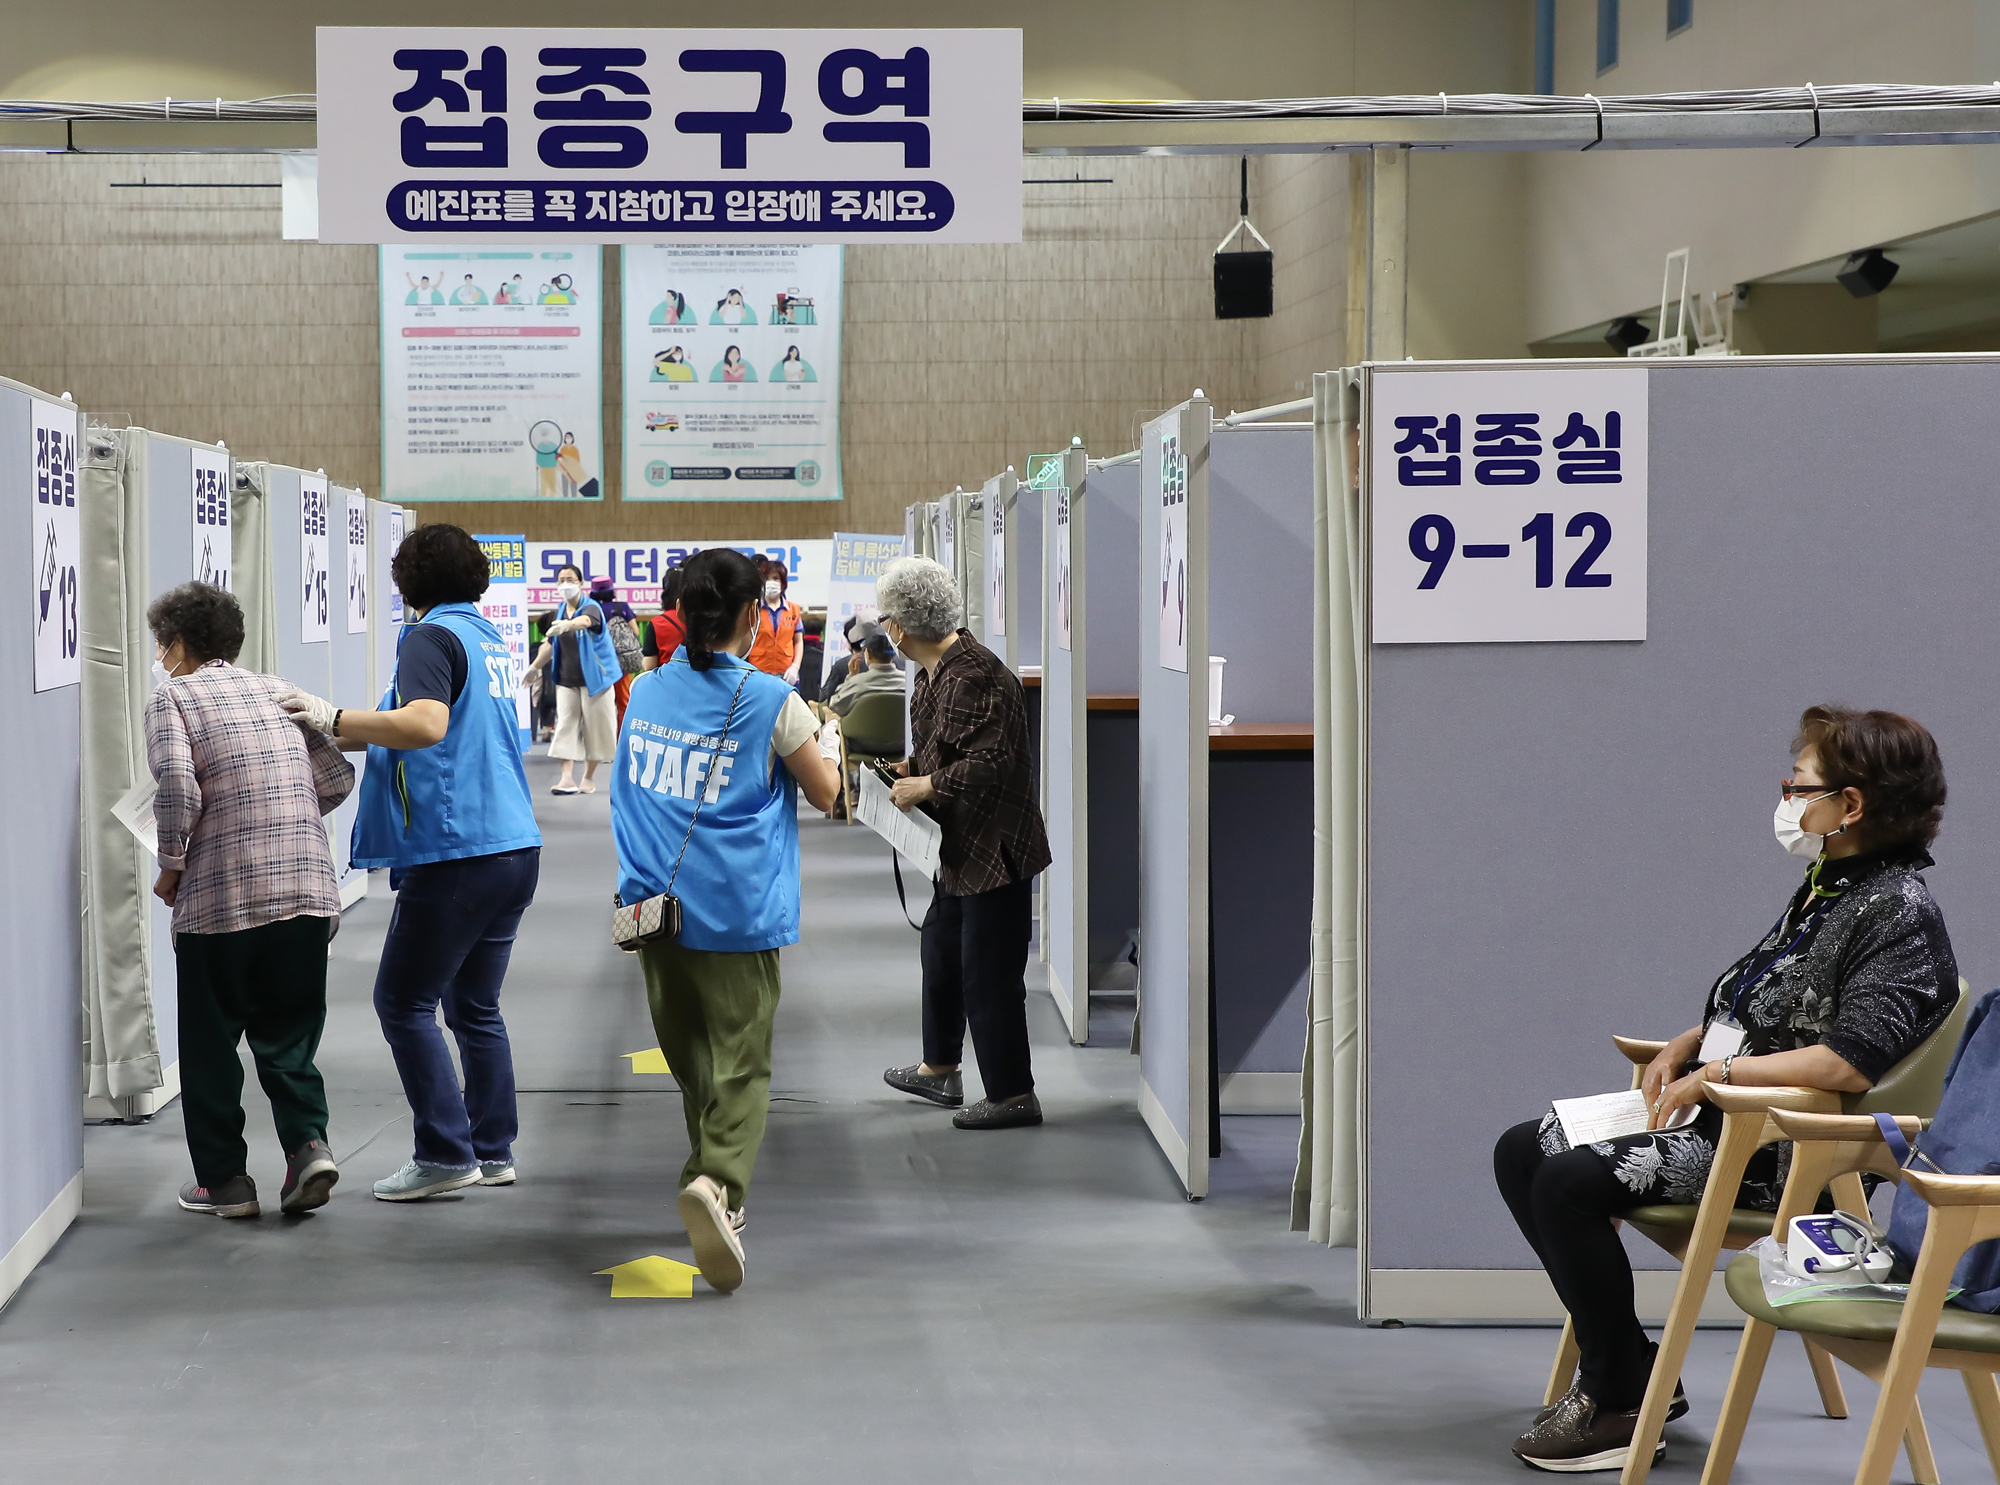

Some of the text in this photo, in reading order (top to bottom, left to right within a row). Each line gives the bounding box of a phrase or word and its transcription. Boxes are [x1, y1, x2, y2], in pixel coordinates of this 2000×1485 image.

[392, 45, 931, 169] 접종구역
[405, 188, 937, 223] 예진표를 꼭 지참하고 입장해 주세요.
[37, 427, 75, 507] 접종실
[1162, 436, 1184, 507] 접종실
[1394, 411, 1622, 486] 접종실
[196, 468, 227, 526] 접종실
[304, 490, 326, 536] 접종실
[349, 508, 365, 545] 접종실
[512, 542, 523, 559] 및
[1408, 511, 1612, 589] 9-12
[358, 573, 365, 620] 16
[504, 560, 523, 578] 발급
[59, 565, 77, 659] 13
[316, 570, 327, 625] 15
[515, 623, 523, 636] 후
[630, 718, 650, 733] 동작구
[649, 723, 682, 741] 코로나19
[628, 734, 735, 804] STAFF
